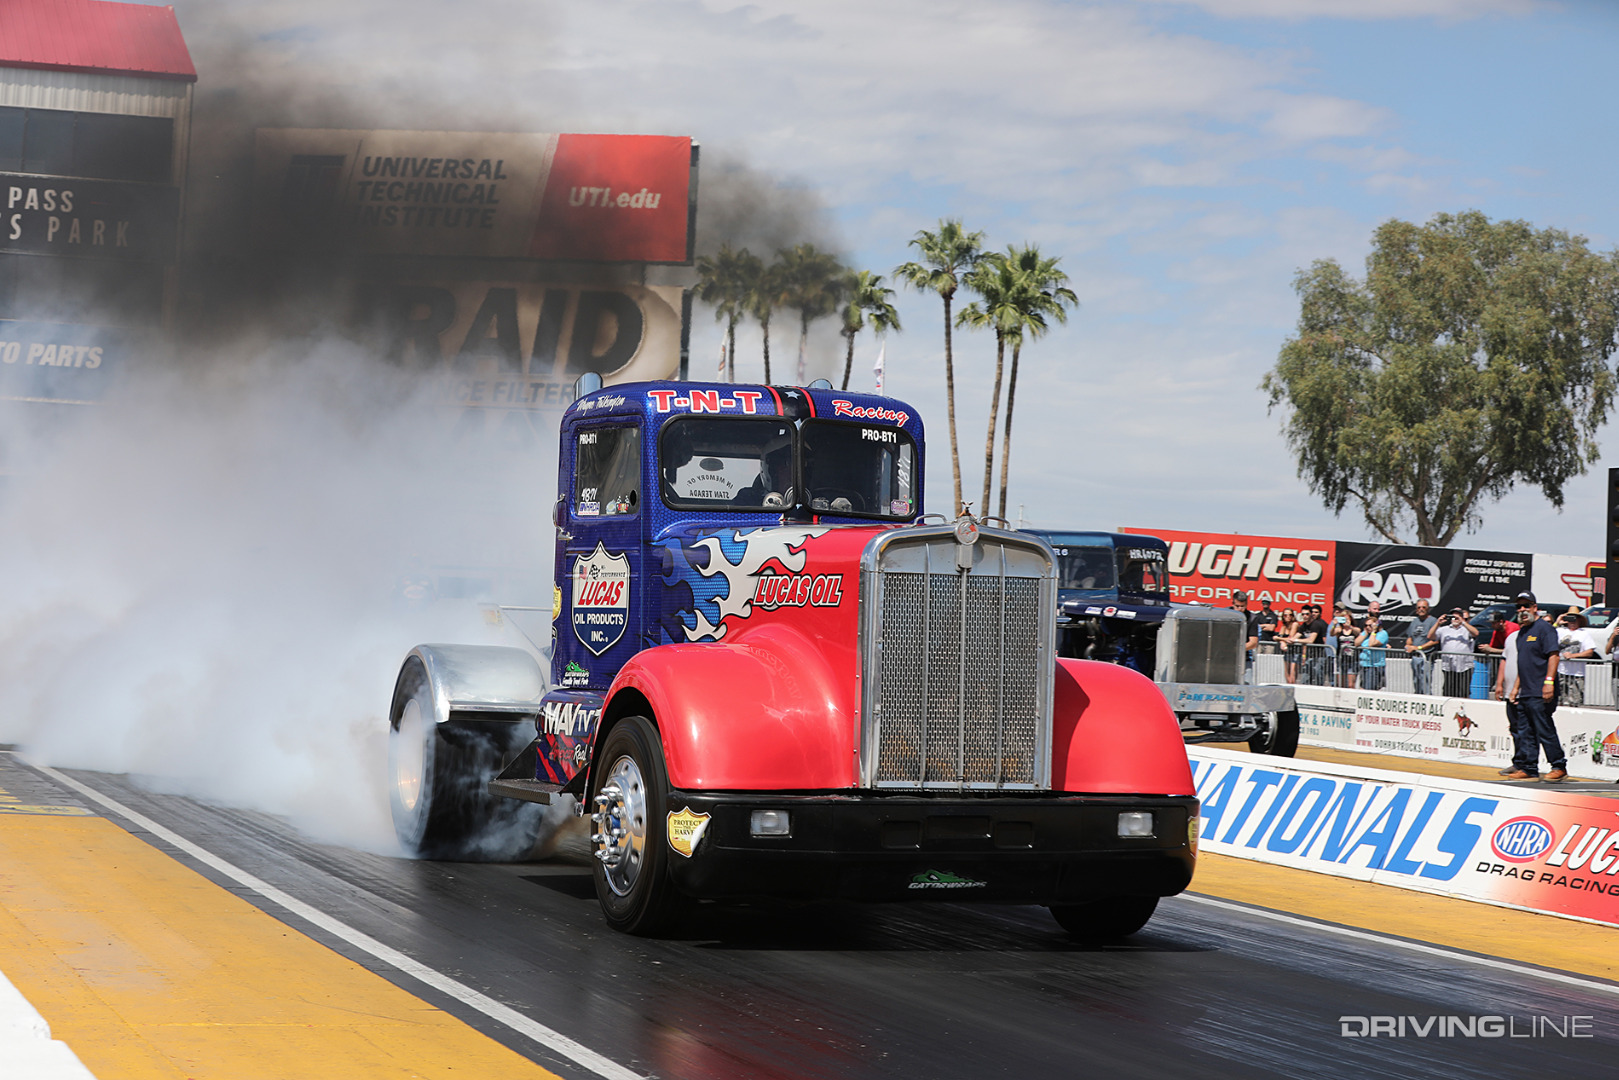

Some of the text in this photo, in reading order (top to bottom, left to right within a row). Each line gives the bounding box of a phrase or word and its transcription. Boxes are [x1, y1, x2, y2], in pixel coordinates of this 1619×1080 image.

[362, 155, 508, 180] UNIVERSAL
[8, 186, 74, 213] PASS
[356, 180, 502, 205] TECHNICAL
[568, 186, 661, 209] UTI.edu
[353, 205, 497, 230] INSTITUTE
[46, 215, 129, 247] PARK
[26, 343, 104, 369] PARTS
[648, 389, 762, 414] T-N-T
[832, 400, 909, 426] Racing
[861, 429, 897, 443] PRO-BT1
[1164, 540, 1329, 585] UGHES
[577, 580, 625, 606] LUCAS
[752, 574, 844, 607] LUCAS OIL
[1350, 570, 1441, 608] RAD
[574, 613, 624, 626] OIL PRODUCTS
[1356, 696, 1445, 718] ONE SOURCE FOR ALL
[1320, 715, 1353, 730] PAVING
[1356, 714, 1443, 732] OF YOUR WATER TRUCK NEEDS
[1442, 736, 1487, 752] MAVERICK
[1498, 823, 1548, 855] NHRA
[1475, 861, 1536, 881] DRAG
[907, 881, 988, 889] GATORWRAPS
